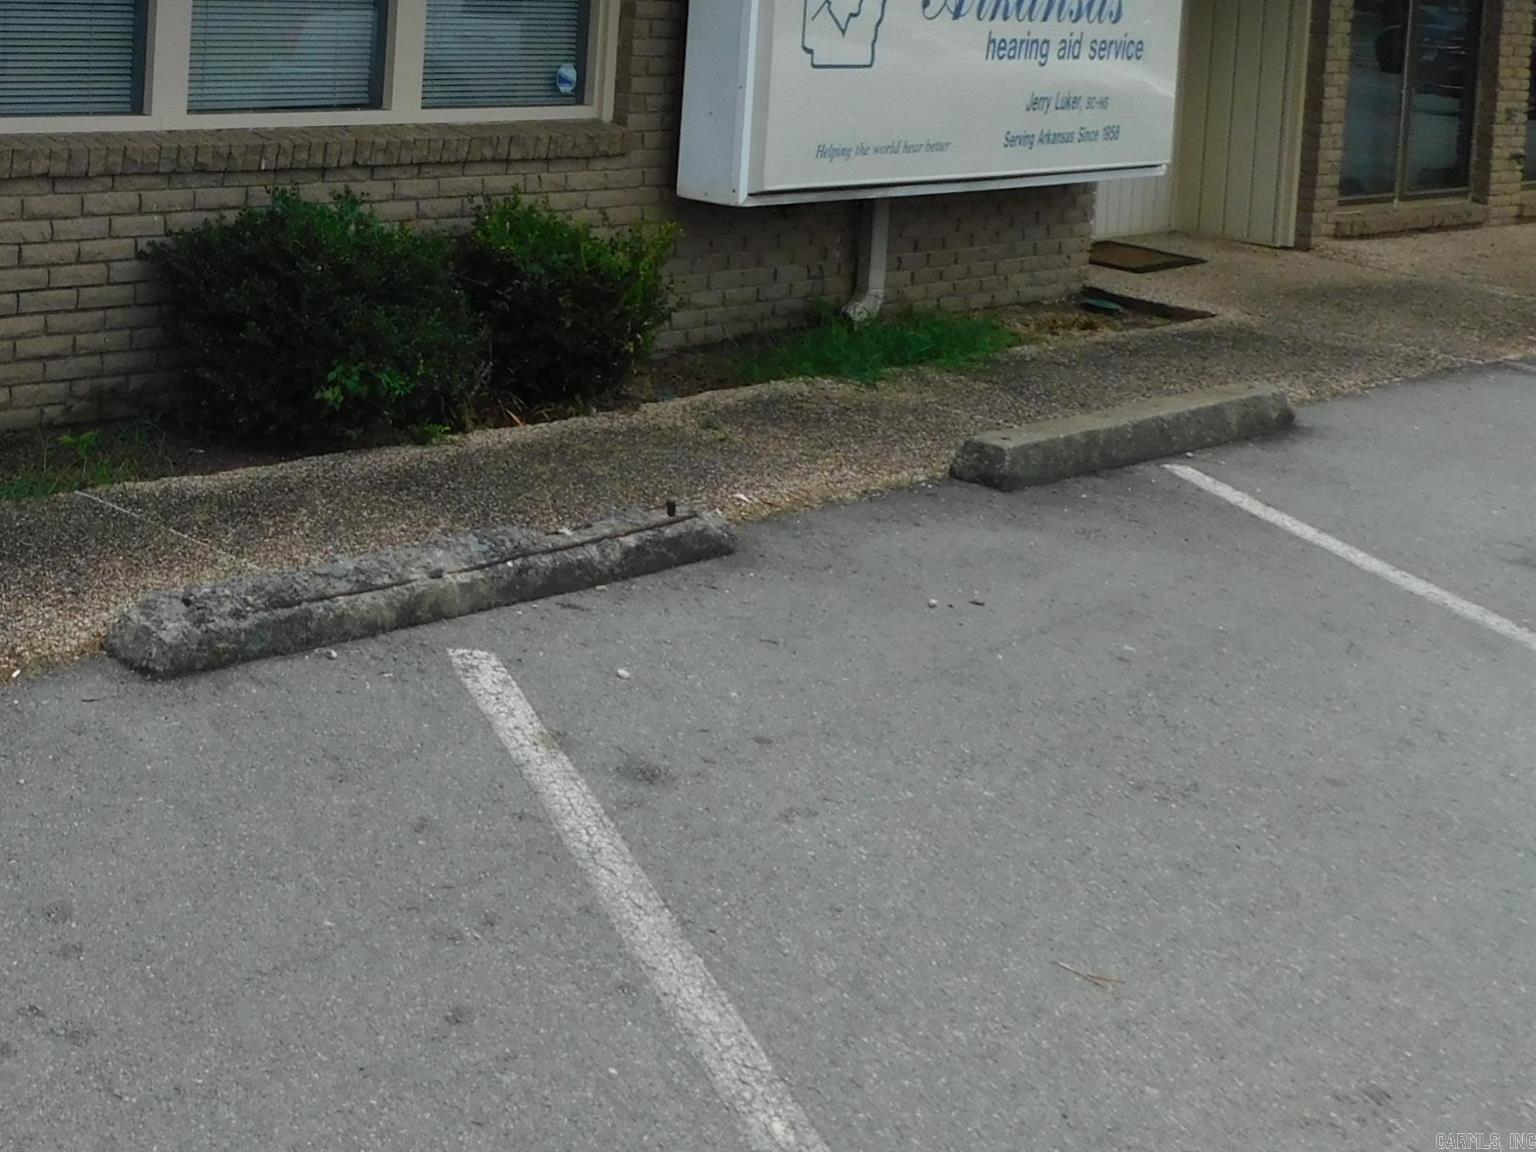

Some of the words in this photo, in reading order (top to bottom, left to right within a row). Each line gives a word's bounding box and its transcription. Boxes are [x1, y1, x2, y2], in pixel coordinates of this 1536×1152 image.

[985, 30, 1051, 66] hearing
[1057, 32, 1082, 62] aid
[1088, 31, 1145, 62] service
[1026, 91, 1053, 115] Jerry
[1003, 130, 1036, 150] Serving
[1037, 128, 1075, 146] Arkansas
[1077, 126, 1100, 143] Since
[815, 143, 853, 162] Helping
[854, 142, 869, 157] the
